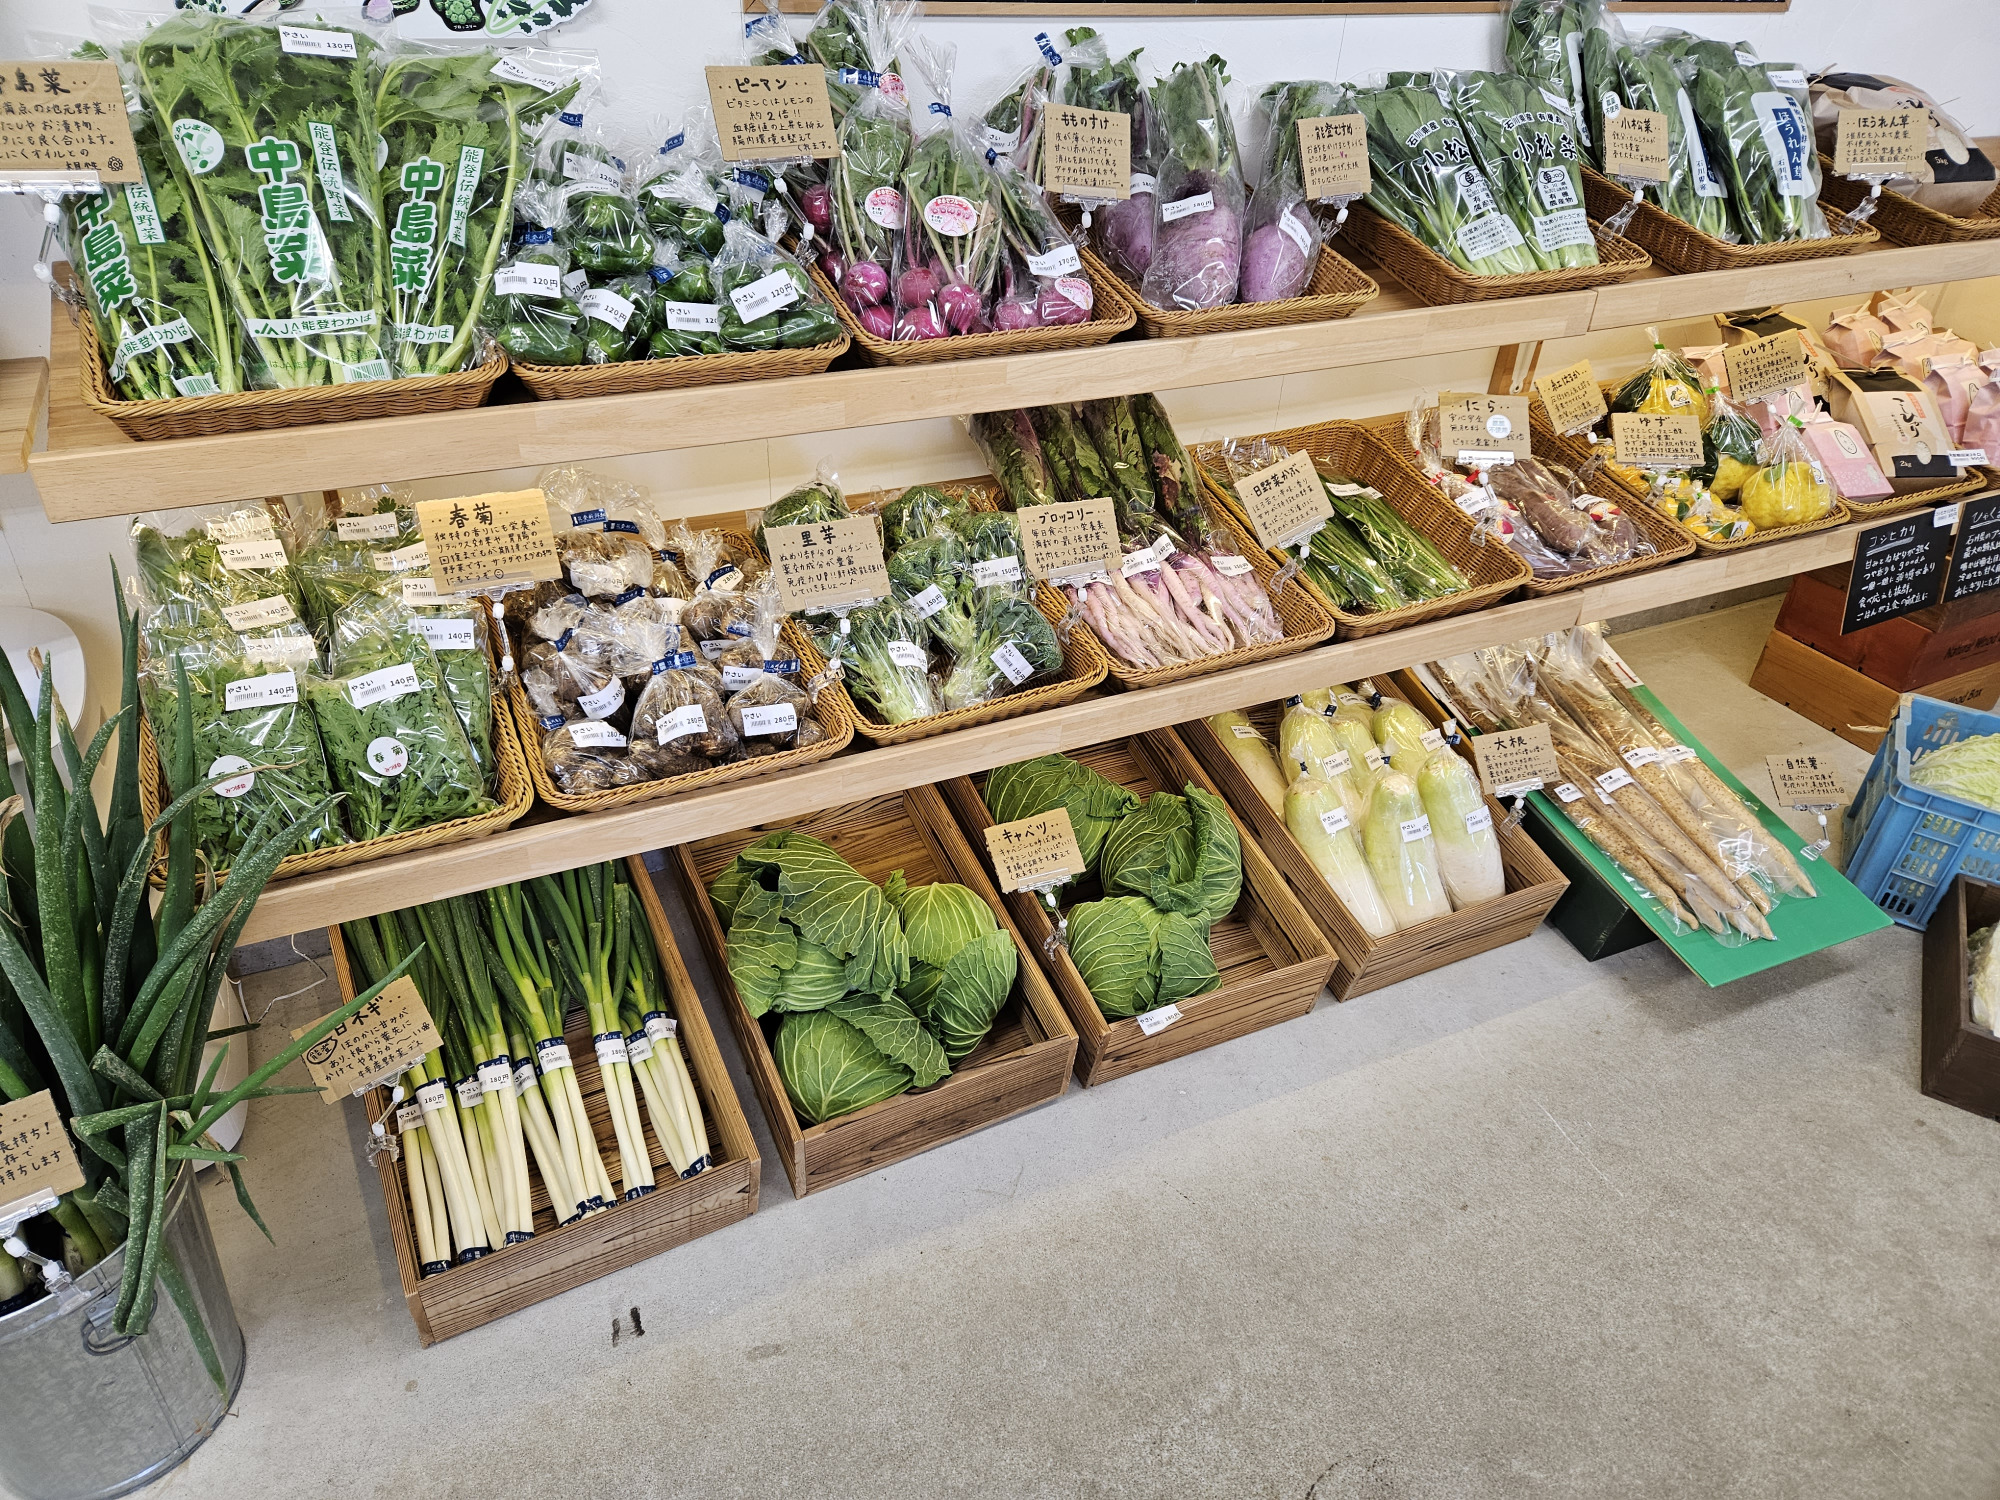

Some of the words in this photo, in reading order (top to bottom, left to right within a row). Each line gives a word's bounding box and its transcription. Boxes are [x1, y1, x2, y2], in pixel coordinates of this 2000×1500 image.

[282, 30, 309, 39] やさい
[326, 42, 354, 50] 130円
[735, 77, 788, 93] ピーマン
[1061, 111, 1110, 129] もものすけ
[1620, 116, 1653, 134] 小松菜
[1858, 113, 1911, 129] ほうれん草
[1513, 132, 1577, 161] 小松菜
[312, 125, 351, 219] 能登伝統野菜
[452, 148, 481, 243] 能登伝統野菜
[250, 139, 326, 281] 中島菜
[393, 160, 440, 290] 中島菜
[532, 277, 558, 287] 120円
[771, 283, 794, 299] 120円
[735, 292, 756, 305] やさい
[605, 304, 628, 322] 120円
[1743, 337, 1779, 356] ししゆず
[1465, 399, 1496, 413] にら
[1638, 416, 1671, 428] ゆず
[1252, 461, 1301, 497] 日野菜かぶ
[449, 502, 494, 529] 春菊
[1038, 507, 1094, 525] ブロッコリー
[373, 523, 396, 532] 140円
[800, 525, 837, 548] 里芋
[1868, 524, 1917, 548] コシヒカリ
[221, 548, 244, 556] やさい
[974, 566, 991, 574] やさい
[1001, 566, 1019, 576] 150円
[446, 569, 493, 586] にもどうぞ
[225, 609, 249, 618] やさい
[448, 632, 472, 641] 140円
[389, 675, 416, 688] 140円
[724, 671, 744, 679] やさい
[227, 684, 252, 694] やさい
[268, 685, 295, 696] 140円
[351, 679, 374, 691] やさい
[581, 697, 601, 707] やさい
[686, 716, 705, 725] 280円
[743, 711, 763, 720] やさい
[774, 714, 795, 724] 280円
[658, 717, 675, 729] やさい
[572, 725, 594, 736] やさい
[1493, 735, 1528, 751] 大根
[1786, 756, 1818, 770] 自然薯
[1001, 821, 1048, 845] キャベツ
[340, 1006, 410, 1051] ほのかに甘みが
[328, 1019, 413, 1069] あり、根から葉先に
[309, 1042, 333, 1061] 能登
[539, 1050, 557, 1060] やさい
[489, 1073, 510, 1083] 180円
[459, 1085, 479, 1096] やさい
[424, 1094, 445, 1104] 180円
[398, 1109, 417, 1120] やさい
